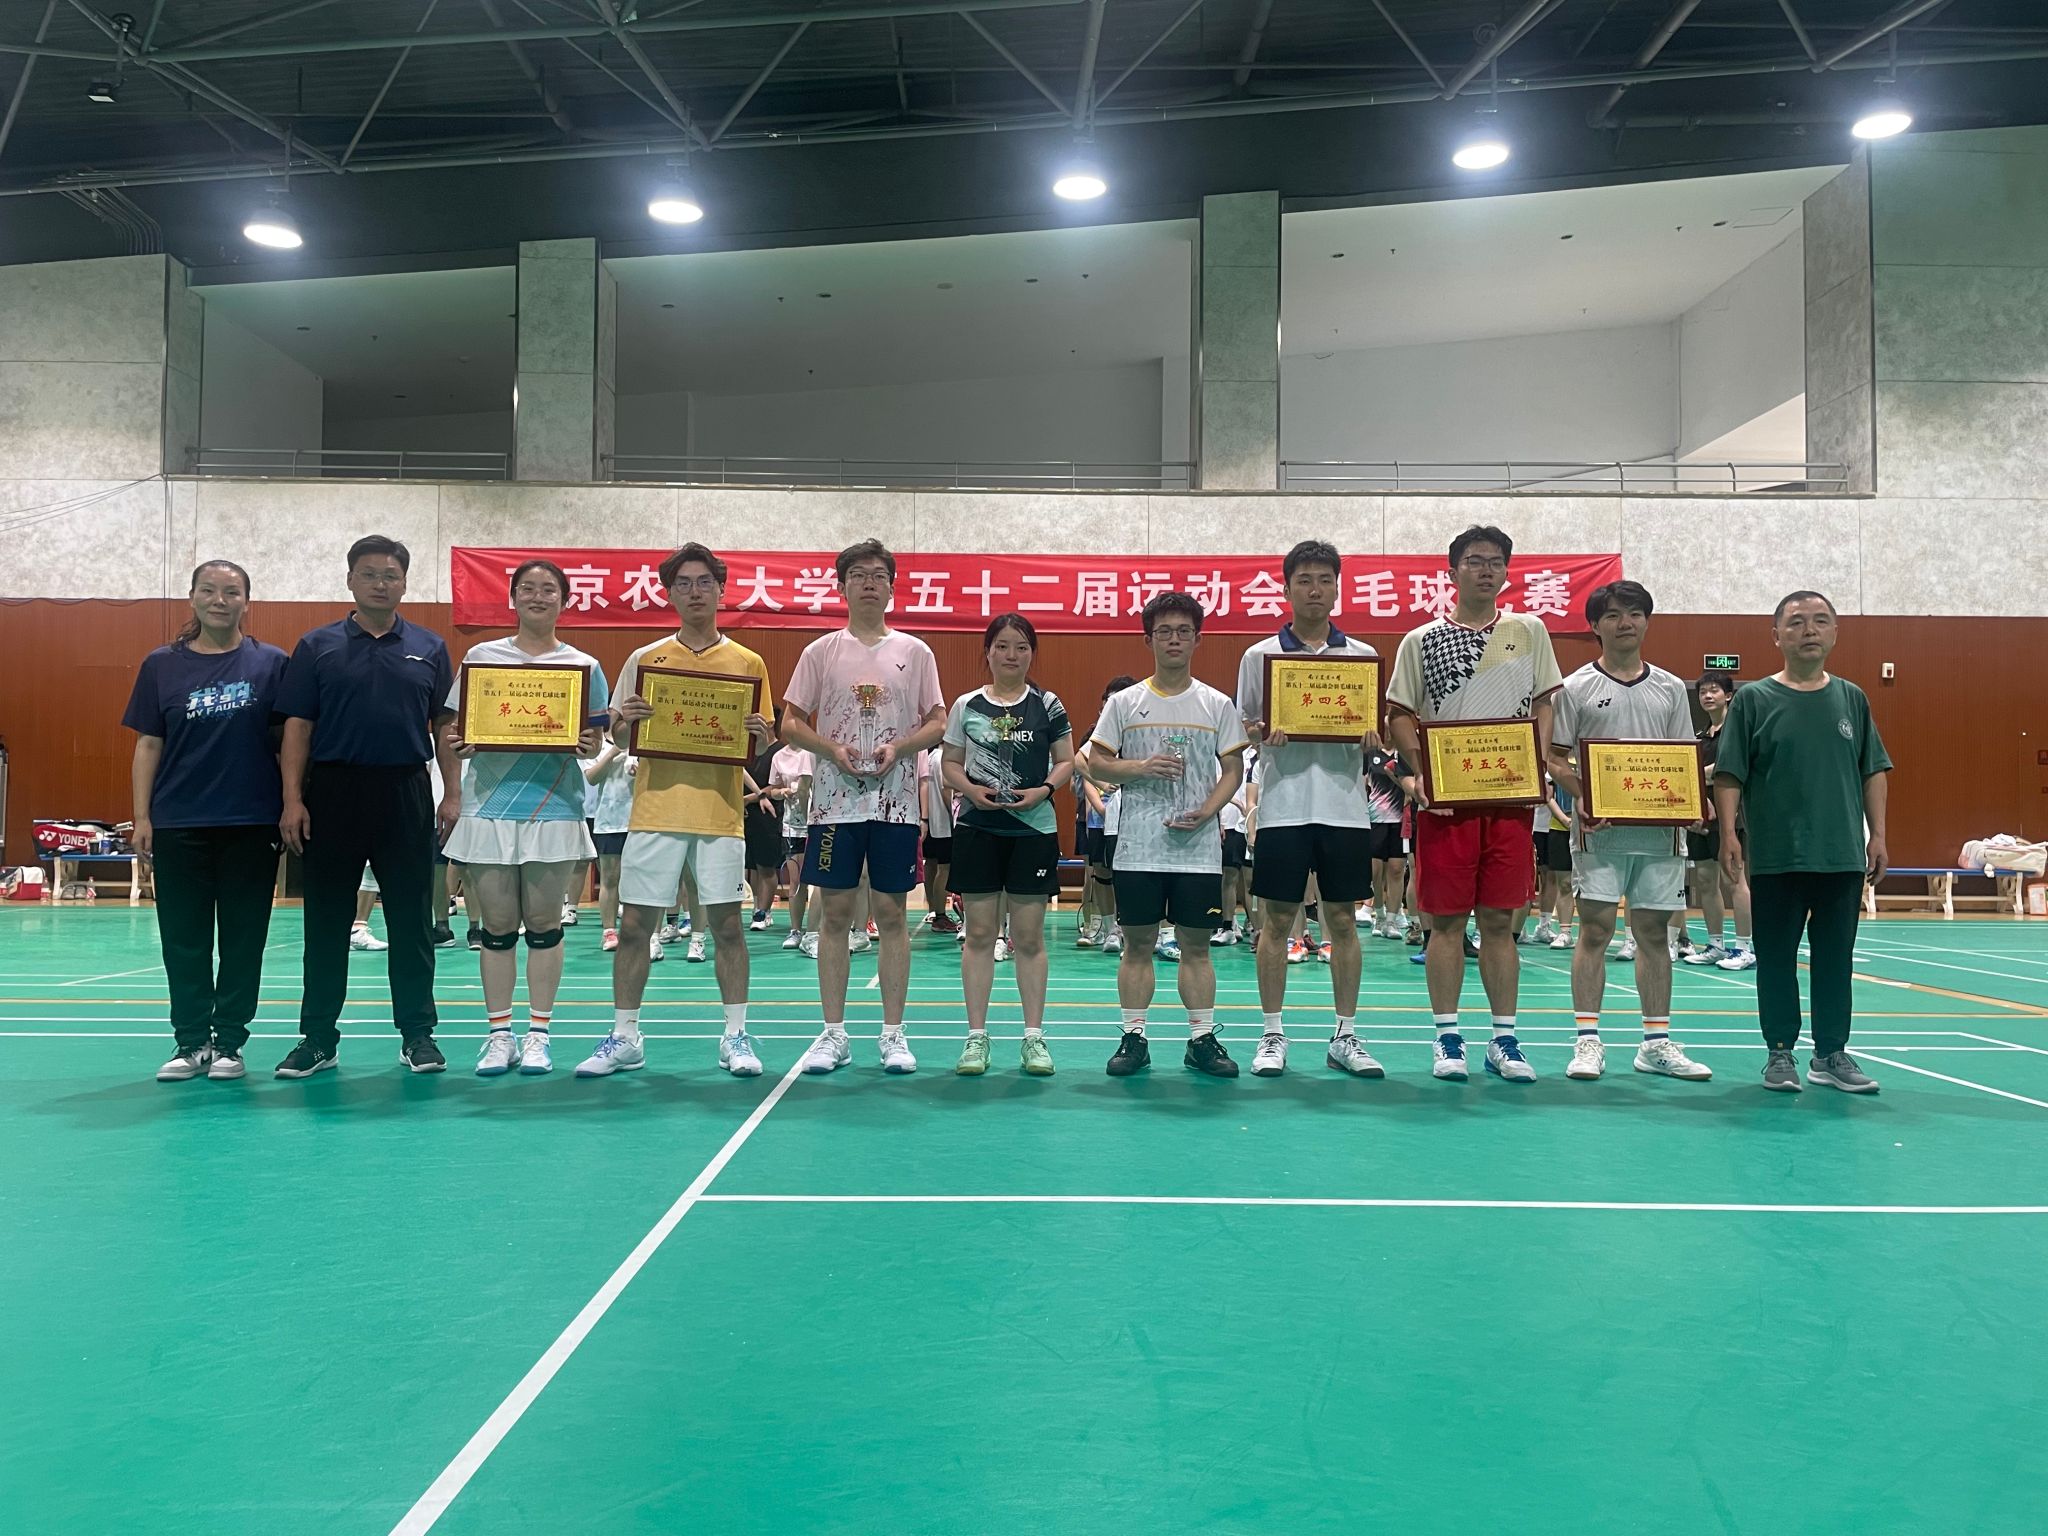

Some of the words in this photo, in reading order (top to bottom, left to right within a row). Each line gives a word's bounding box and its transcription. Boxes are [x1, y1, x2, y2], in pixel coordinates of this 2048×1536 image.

[1301, 692, 1347, 707] 第四名
[187, 708, 204, 720] MY
[498, 702, 547, 717] 第八名
[672, 712, 719, 728] 第七名
[1462, 757, 1508, 772] 第五名
[1622, 777, 1669, 791] 第六名
[58, 832, 91, 847] YONEX
[818, 832, 835, 872] YONEX
